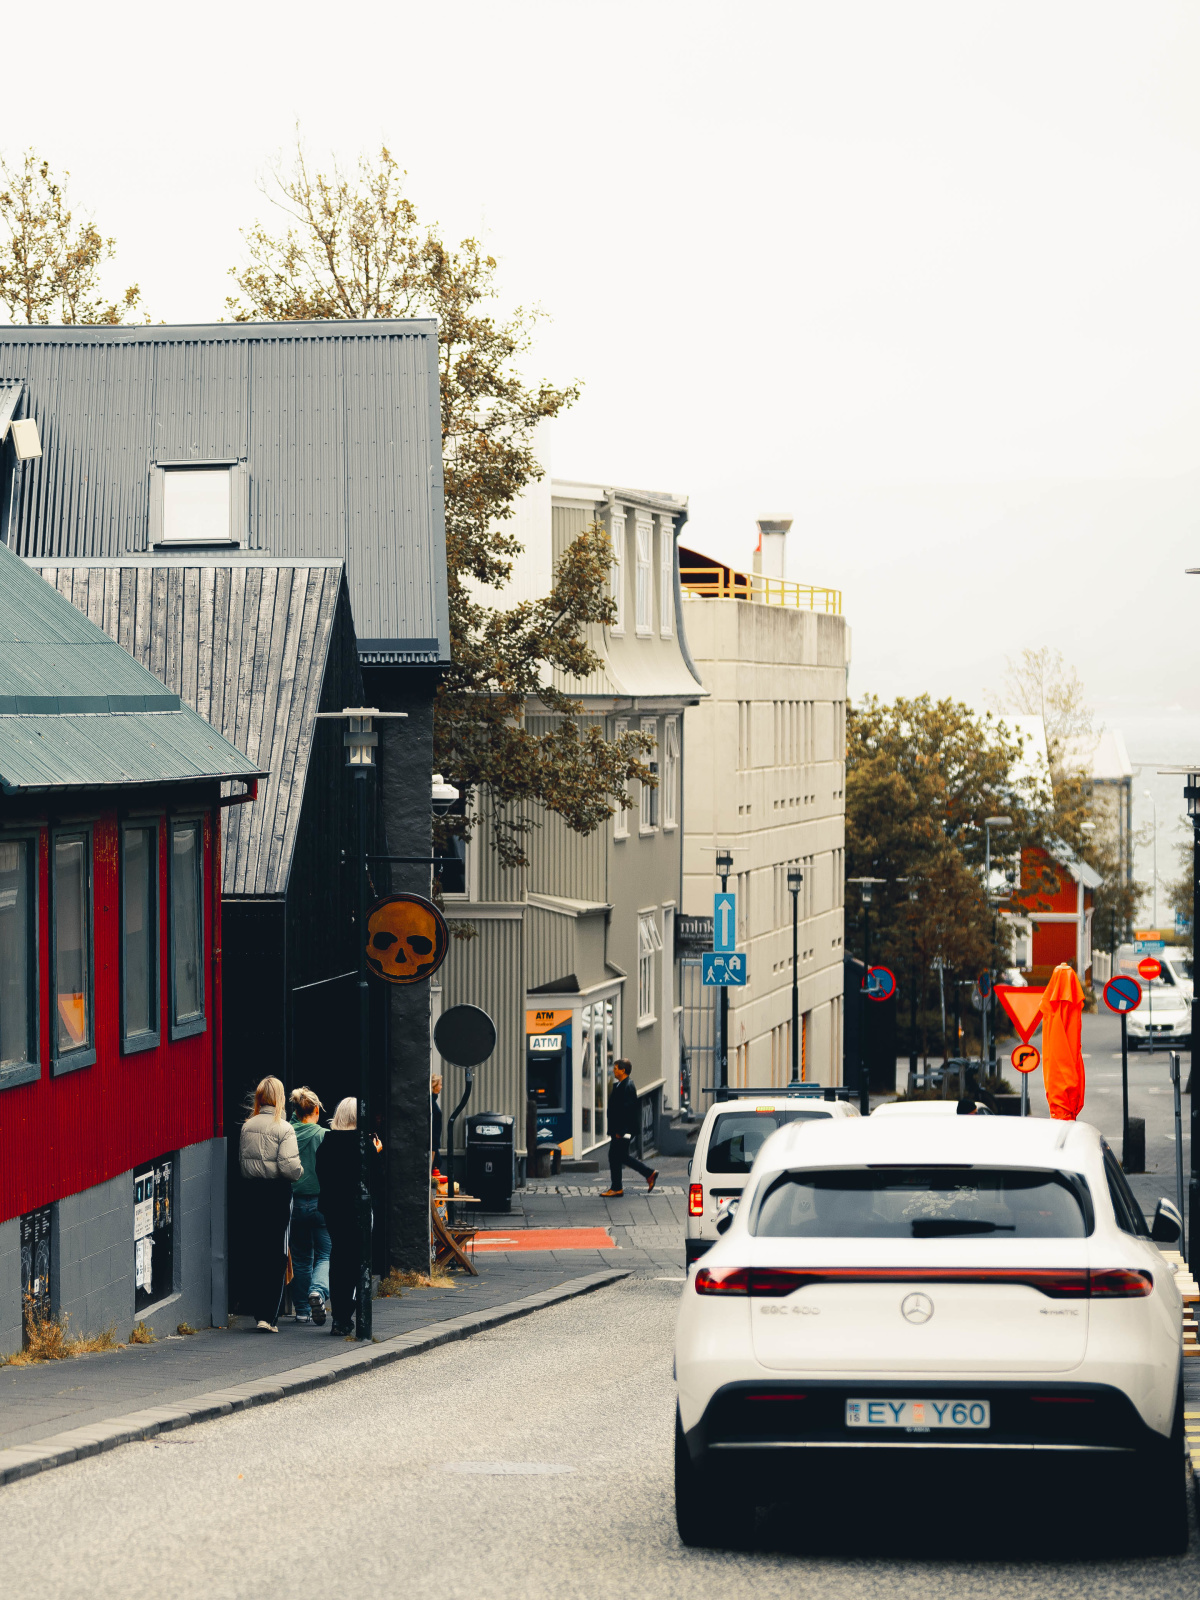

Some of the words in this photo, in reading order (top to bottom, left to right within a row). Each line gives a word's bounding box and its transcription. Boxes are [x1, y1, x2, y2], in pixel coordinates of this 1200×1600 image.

[535, 1011, 554, 1020] ATM
[532, 1037, 559, 1048] ATM
[867, 1402, 906, 1424] EY
[931, 1402, 987, 1426] Y60
